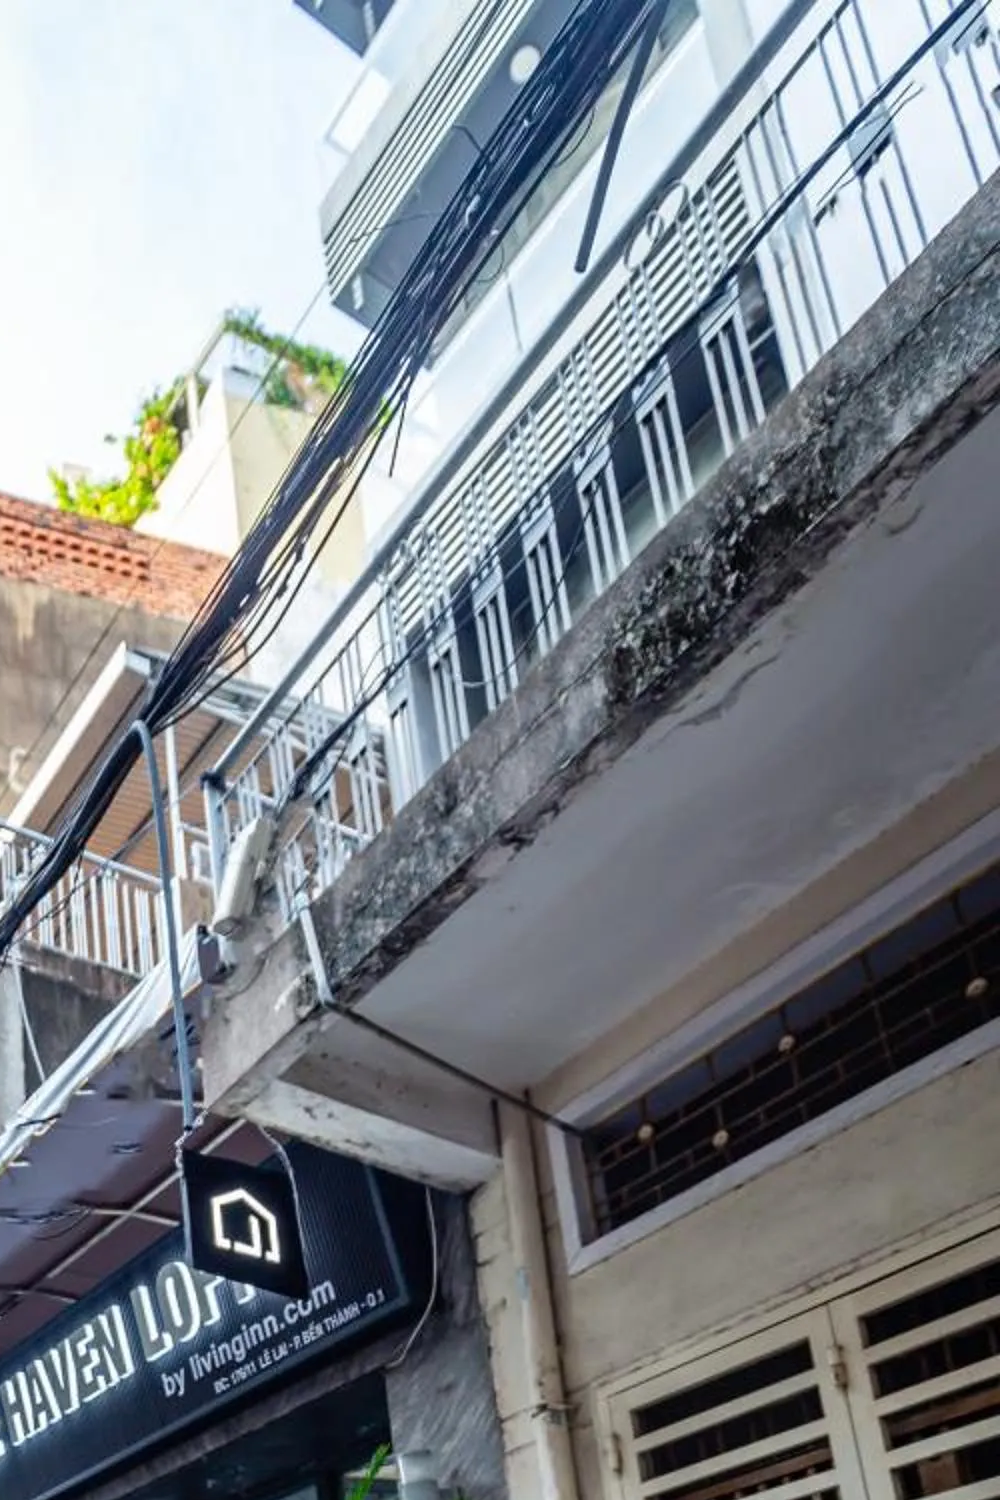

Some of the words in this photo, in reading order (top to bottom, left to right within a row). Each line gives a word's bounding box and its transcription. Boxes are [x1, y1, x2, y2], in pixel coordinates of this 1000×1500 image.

[0, 1304, 135, 1446] HAVEN
[130, 1261, 256, 1362] LOF
[161, 1366, 185, 1397] by
[189, 1279, 336, 1381] livinginn.com
